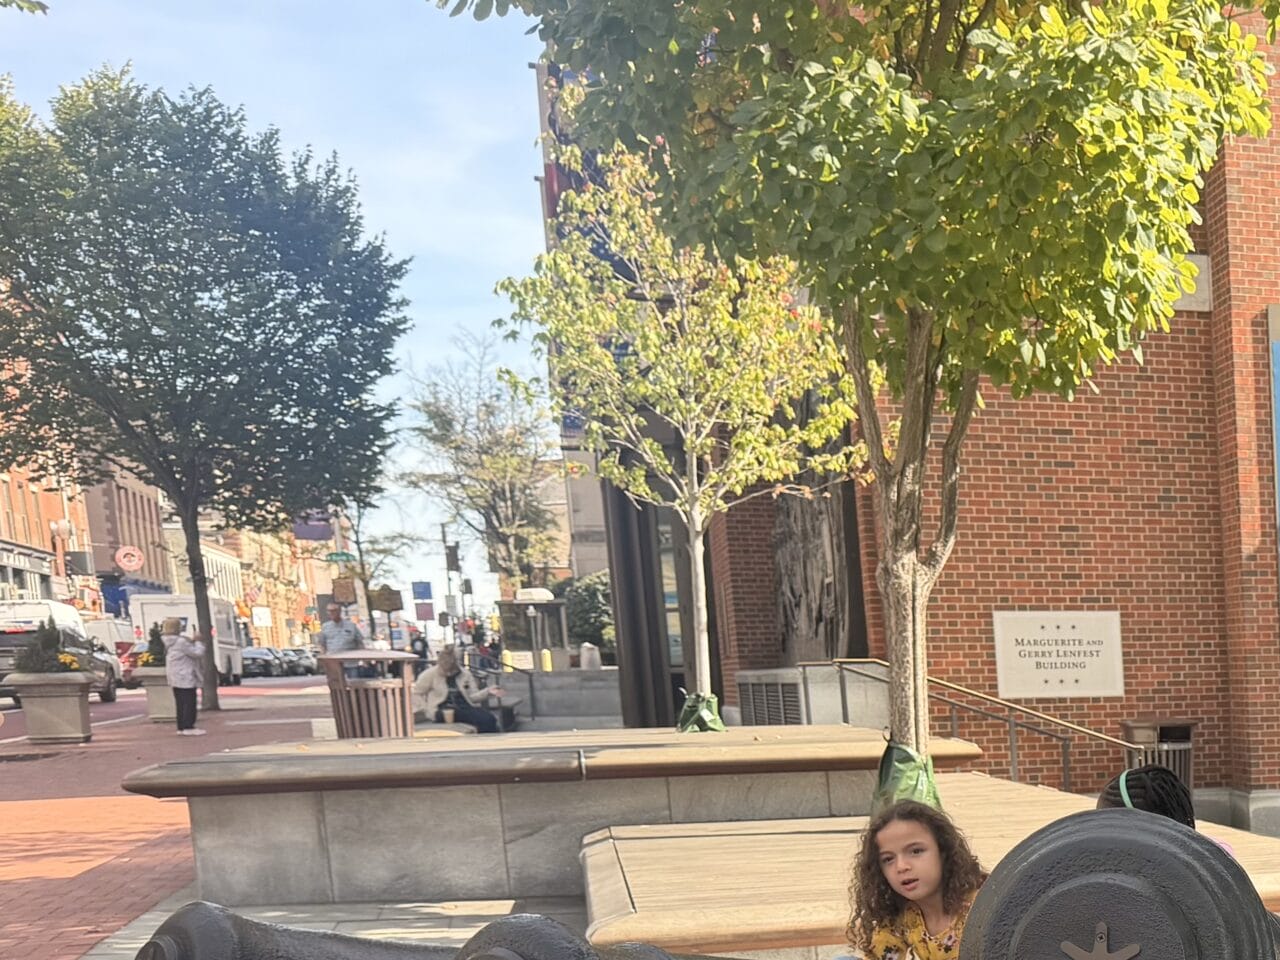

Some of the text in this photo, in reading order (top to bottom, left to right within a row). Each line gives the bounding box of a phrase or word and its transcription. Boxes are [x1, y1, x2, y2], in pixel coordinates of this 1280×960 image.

[1015, 638, 1084, 647] MARGUERITE
[1018, 649, 1101, 658] GERRY LENFEST
[1035, 661, 1086, 670] BUILDING
